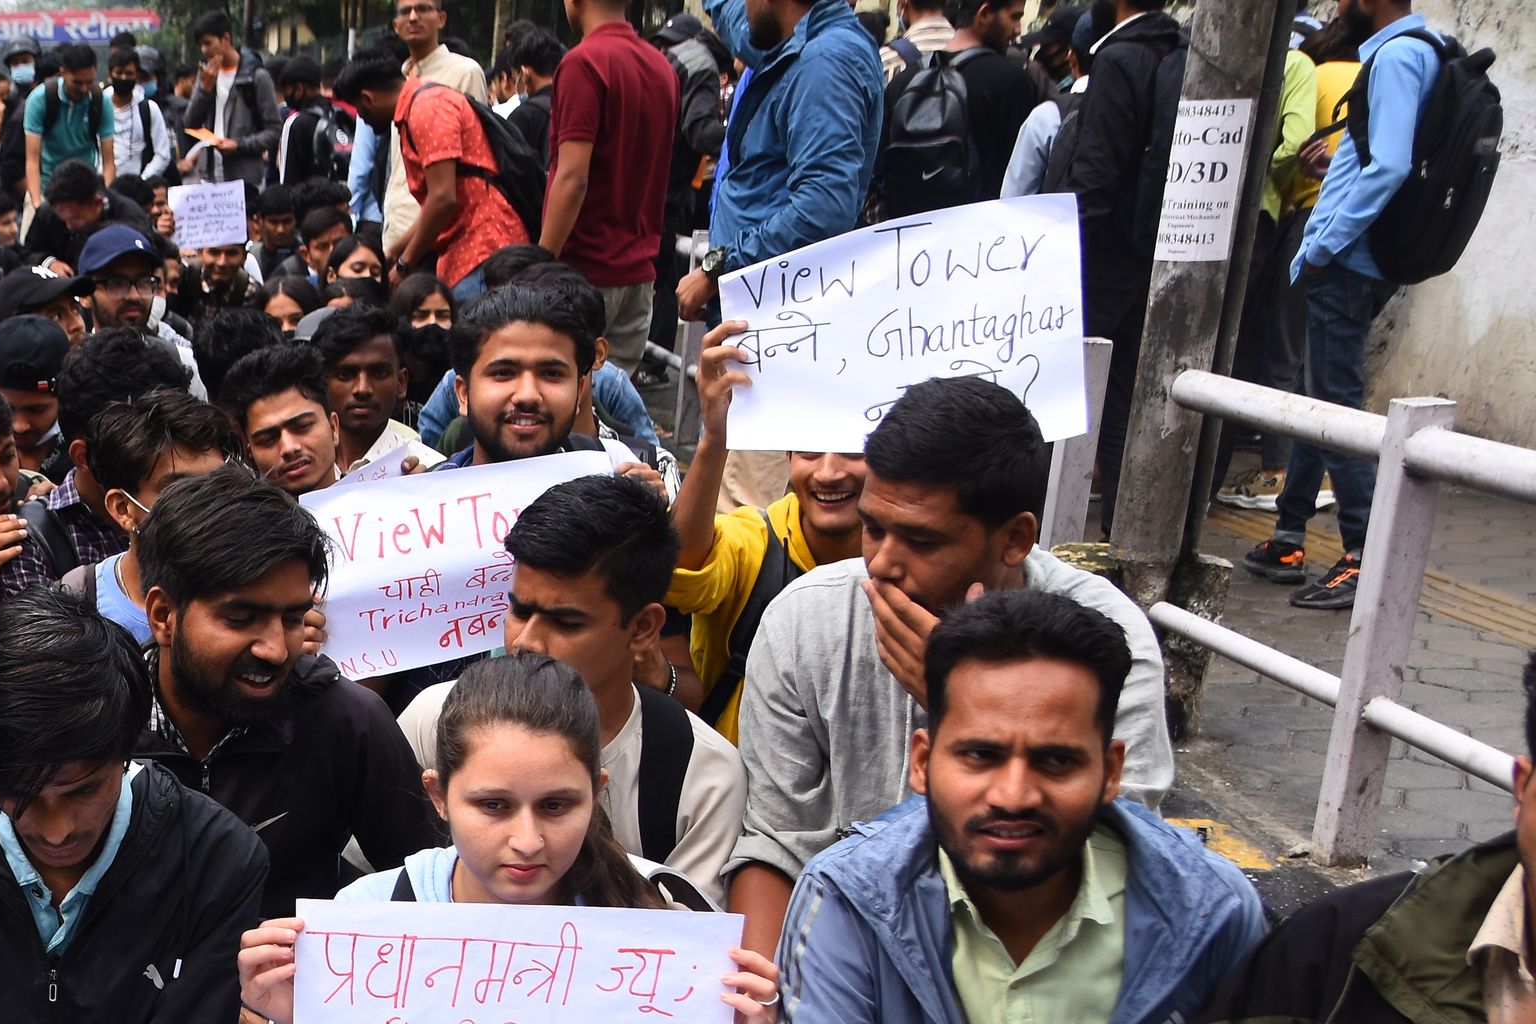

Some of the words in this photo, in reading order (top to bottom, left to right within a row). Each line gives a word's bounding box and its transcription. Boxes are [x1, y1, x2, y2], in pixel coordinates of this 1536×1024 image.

[1216, 201, 1229, 209] on
[874, 222, 1046, 290] Tower
[867, 295, 1074, 363] Ghantaghar
[359, 591, 505, 632] Trichandra
